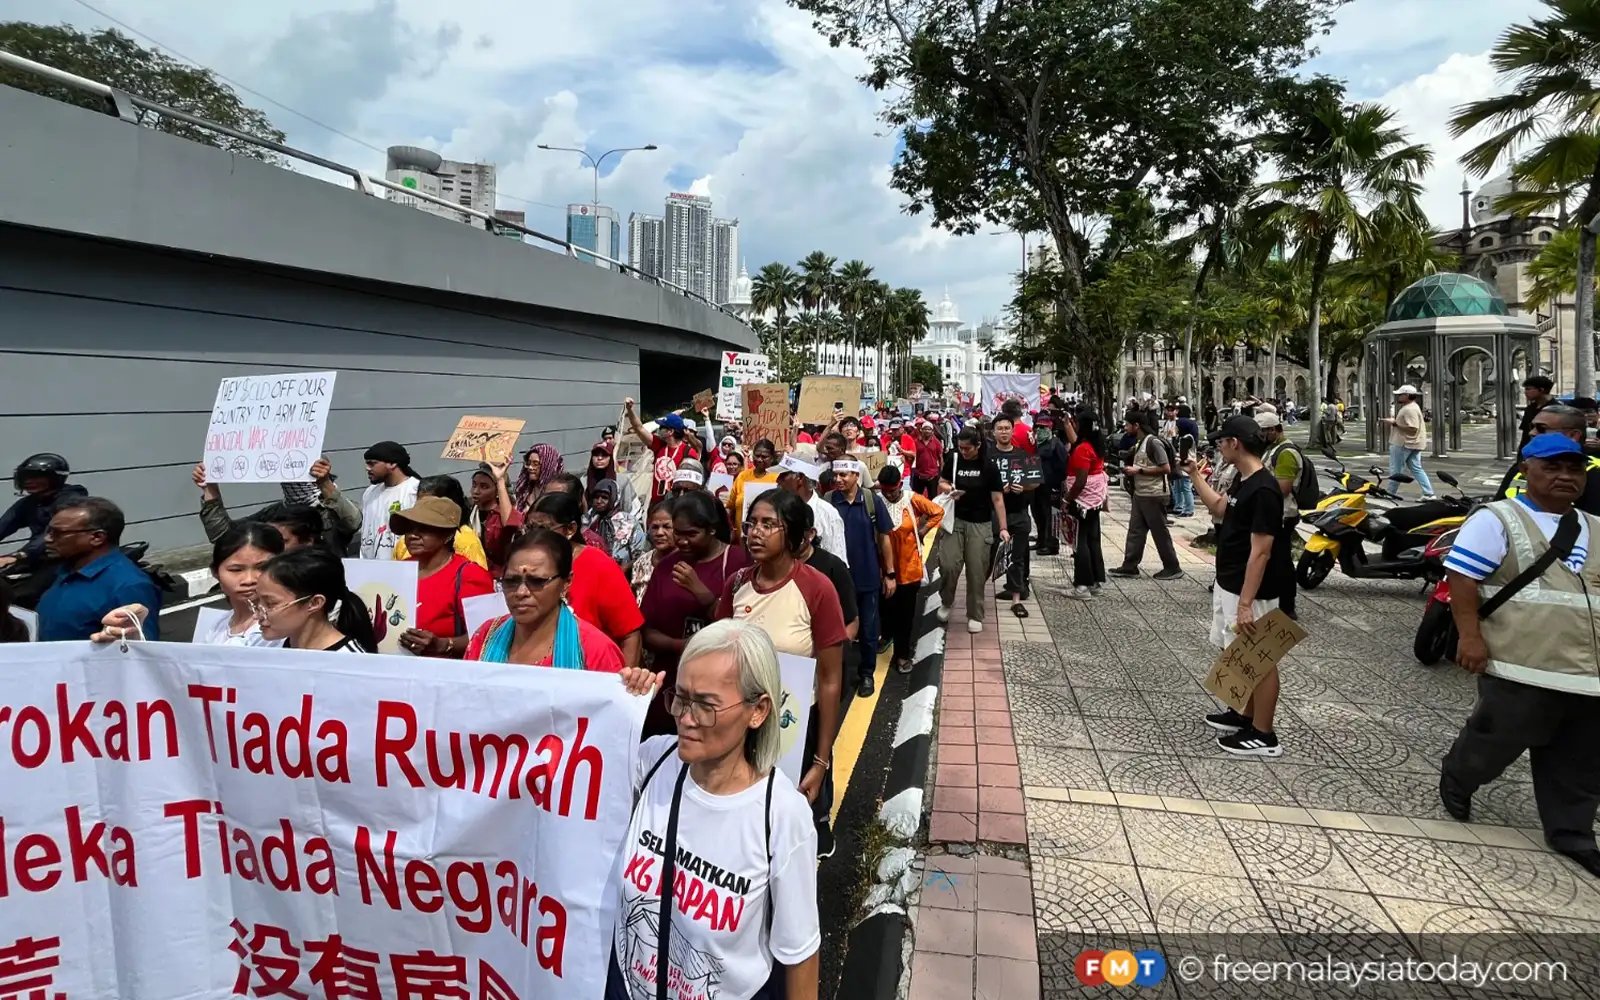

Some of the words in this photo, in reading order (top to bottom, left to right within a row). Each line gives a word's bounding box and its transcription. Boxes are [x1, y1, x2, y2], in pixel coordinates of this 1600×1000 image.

[725, 352, 750, 366] You
[221, 379, 242, 401] THEY
[240, 378, 271, 401] SOLD
[271, 379, 297, 399] OFF
[298, 377, 327, 397] OUR
[211, 405, 254, 425] COUNTRY
[258, 404, 271, 421] TO
[273, 402, 297, 423] ARM
[299, 400, 318, 423] THE
[248, 425, 269, 450] WAR
[271, 424, 319, 450] CRIMINALS
[187, 683, 351, 784] Tiada
[375, 700, 604, 820] Rumah
[623, 850, 655, 893] KG
[638, 829, 752, 896] SELMATKAN
[0, 805, 138, 898] eka
[163, 799, 340, 897] Tiada
[354, 825, 567, 979] Negara
[632, 958, 657, 984] SAMPA
